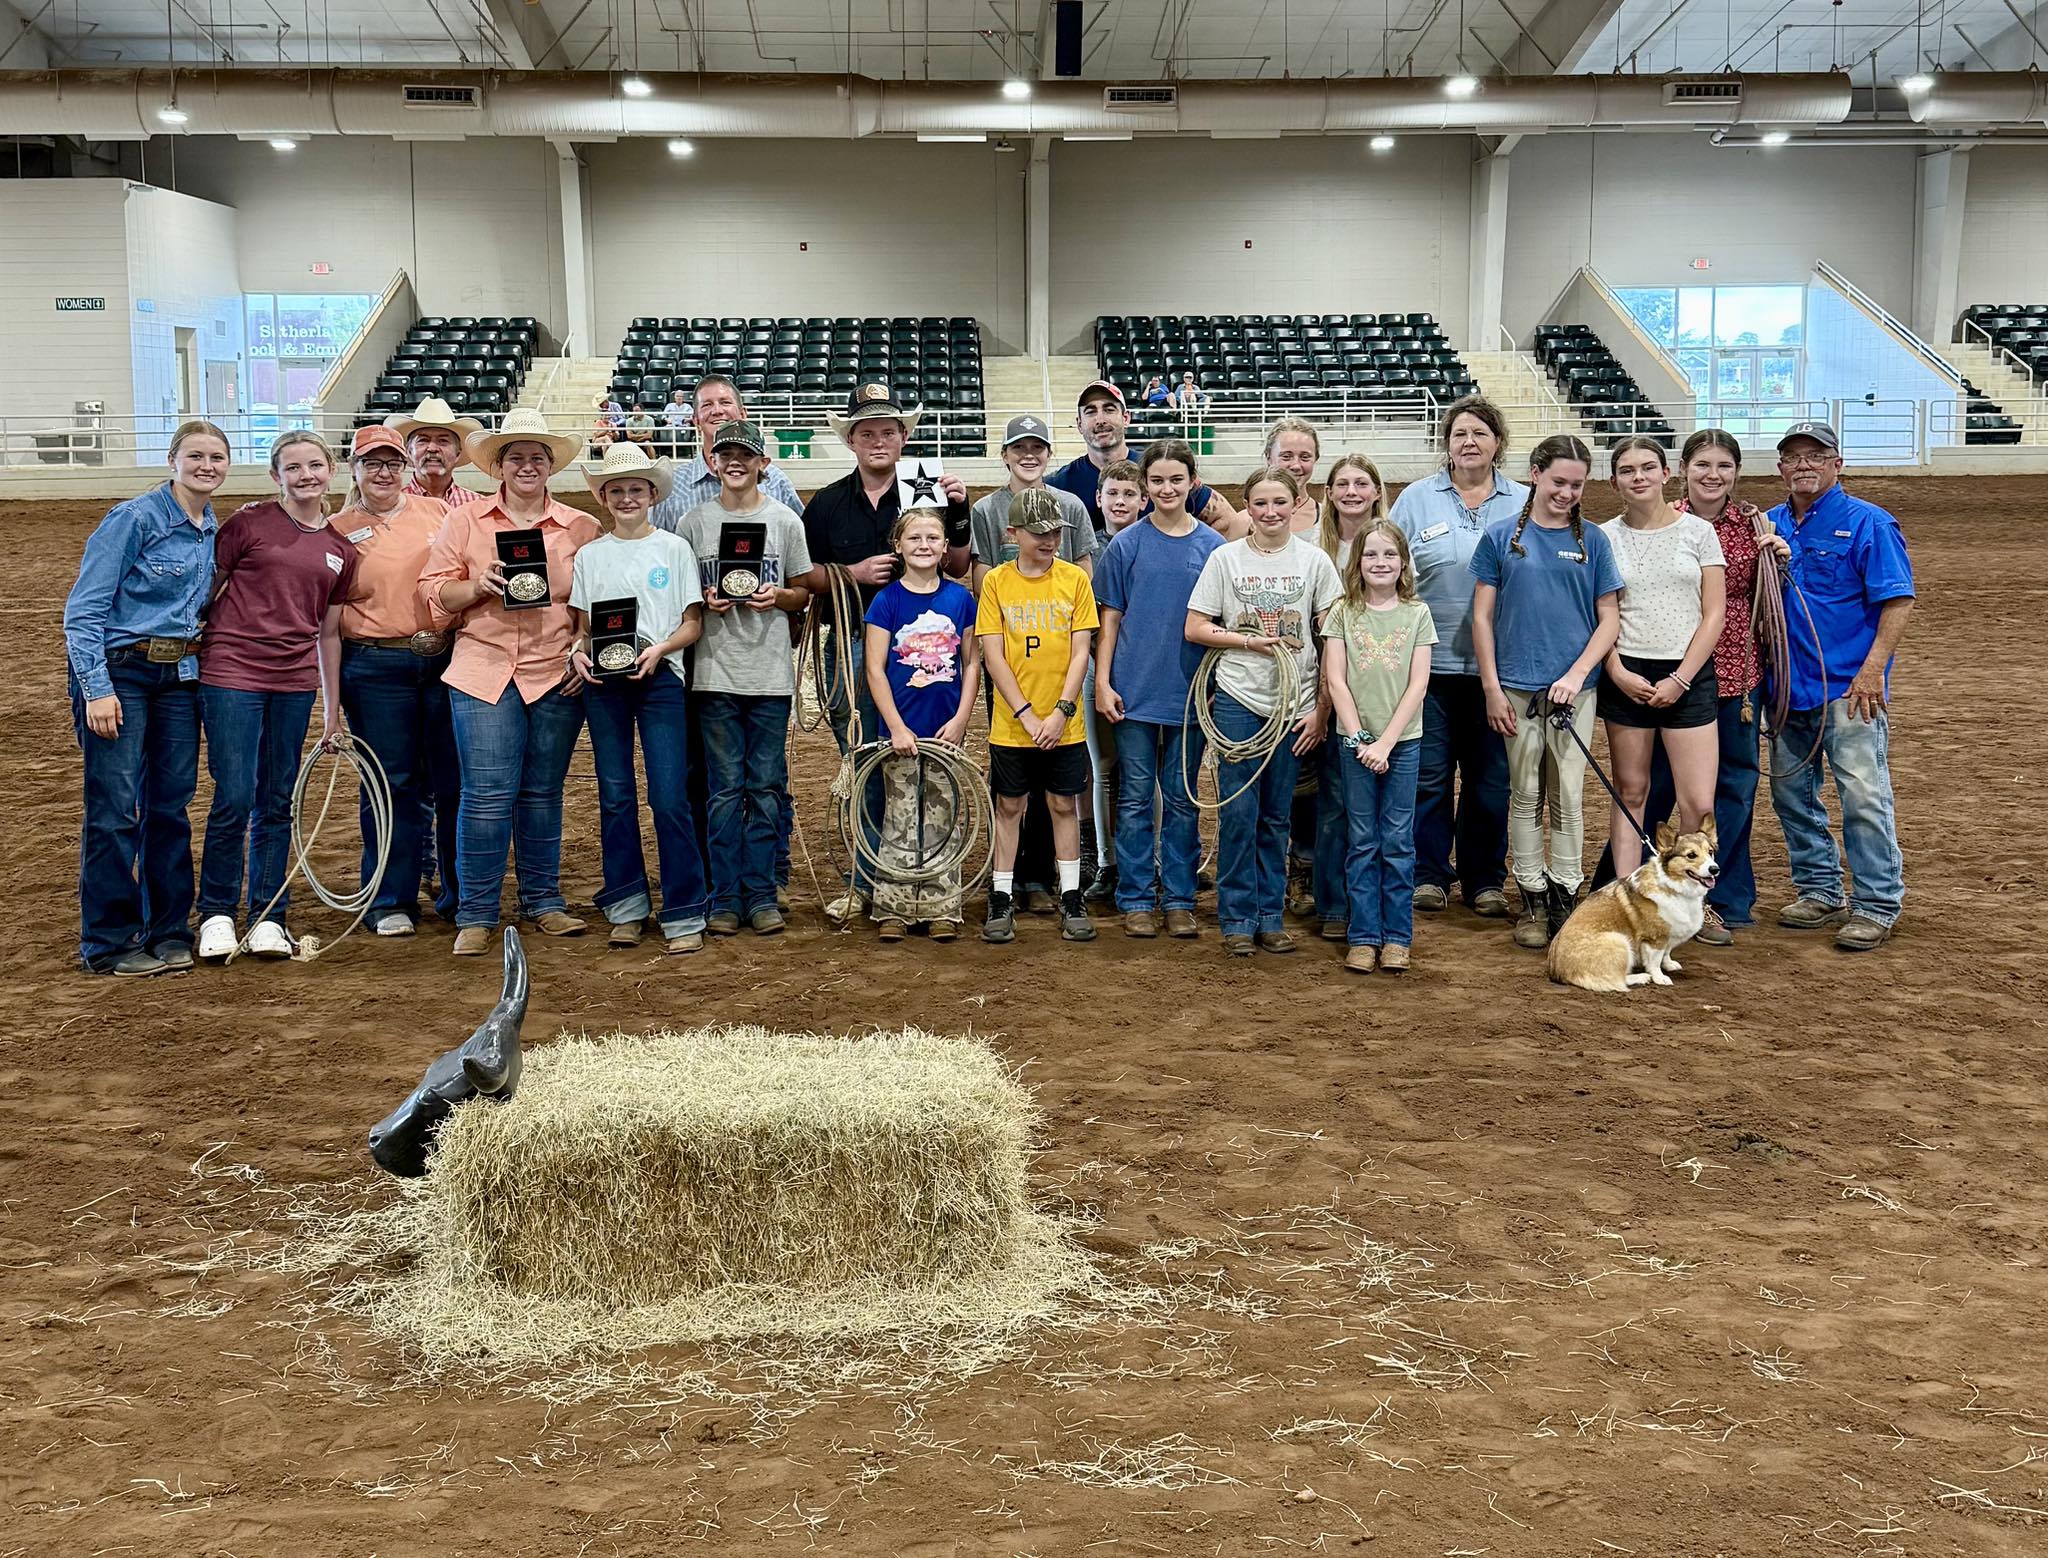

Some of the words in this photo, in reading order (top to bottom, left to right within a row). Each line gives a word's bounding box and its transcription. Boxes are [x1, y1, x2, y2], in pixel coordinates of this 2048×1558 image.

[57, 298, 92, 309] WOMEN
[284, 343, 298, 356] &
[1234, 576, 1261, 591] LAND
[1264, 577, 1277, 590] OF
[1281, 576, 1303, 591] THE
[1025, 635, 1040, 658] P
